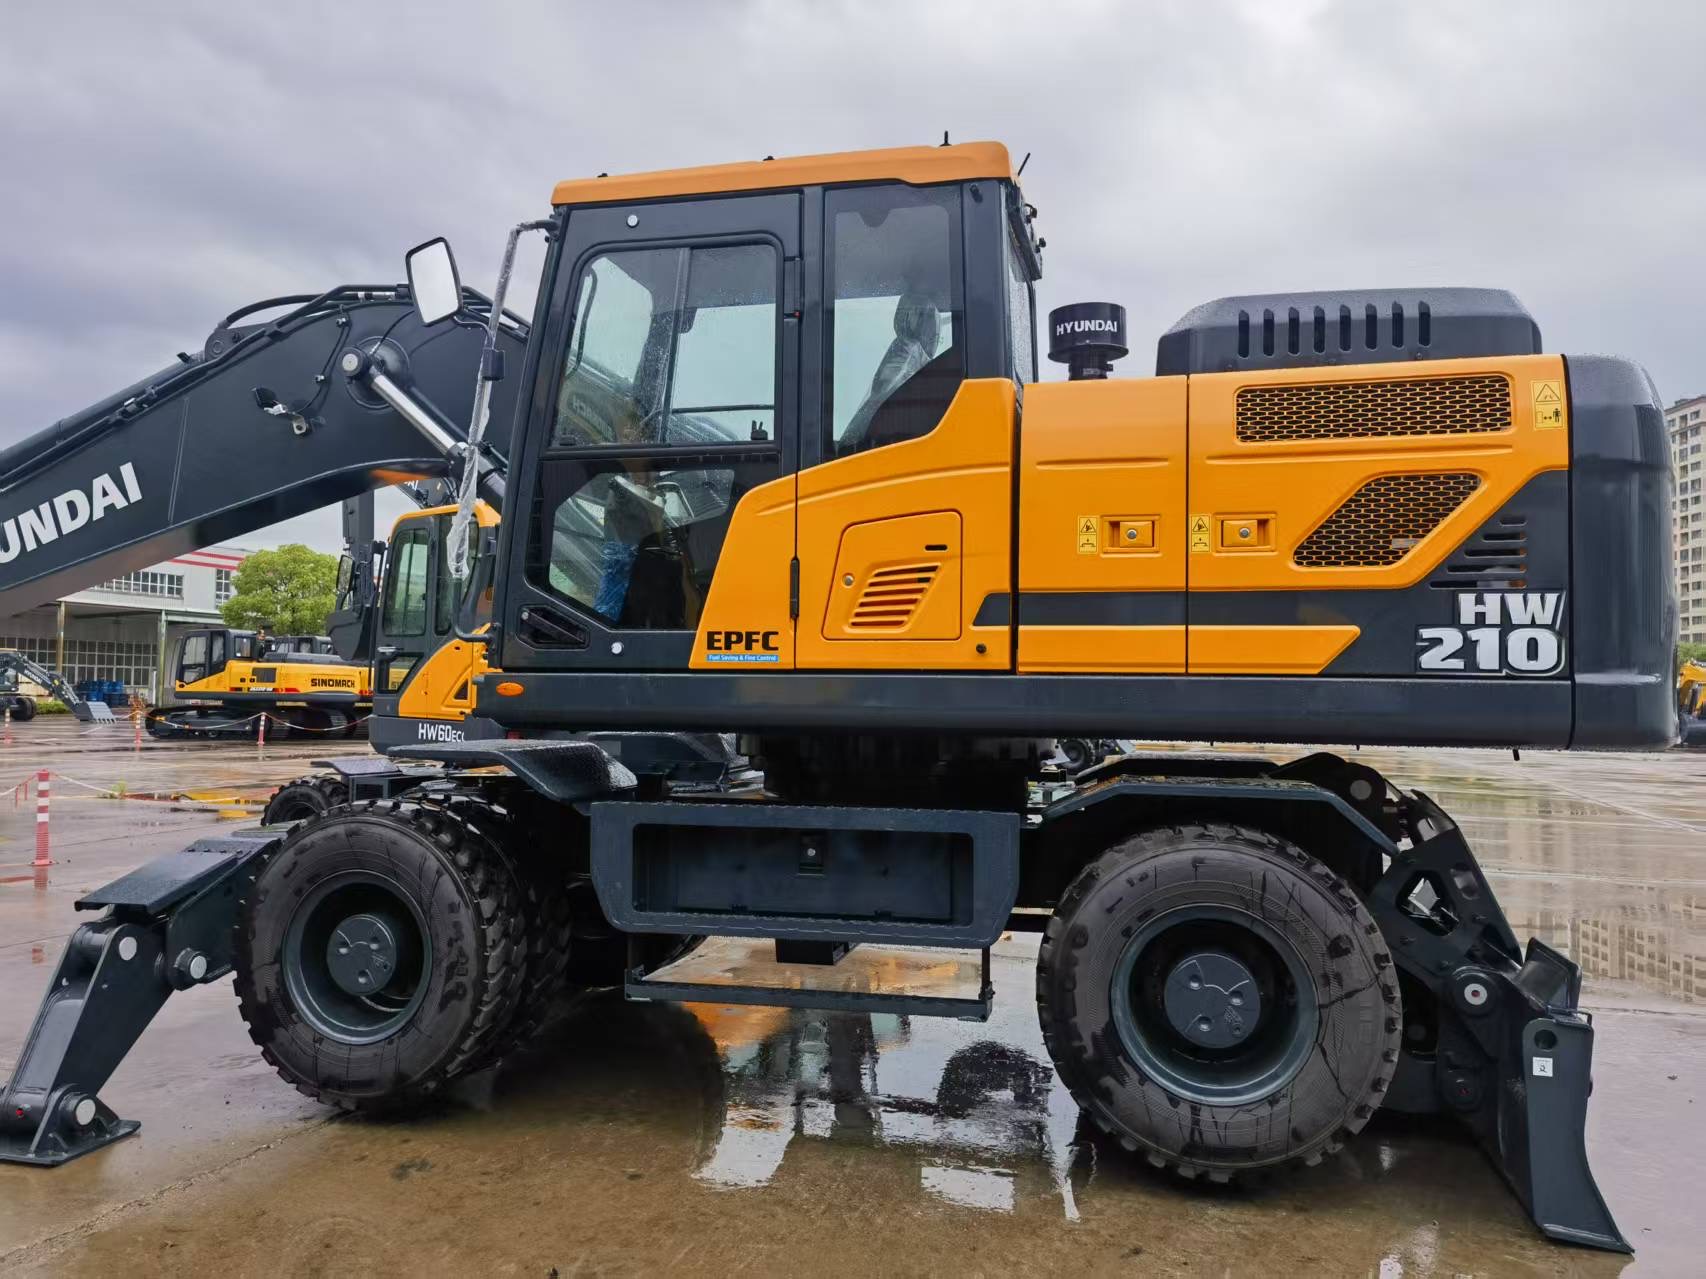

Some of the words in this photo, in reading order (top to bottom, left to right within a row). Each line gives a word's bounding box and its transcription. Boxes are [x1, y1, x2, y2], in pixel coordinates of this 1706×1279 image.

[1056, 320, 1118, 336] HYUNDAI
[0, 461, 142, 563] UNDAI
[1458, 593, 1560, 625] HW
[706, 631, 779, 651] EPFC
[1419, 627, 1558, 670] 210
[310, 678, 355, 688] SINOMACH
